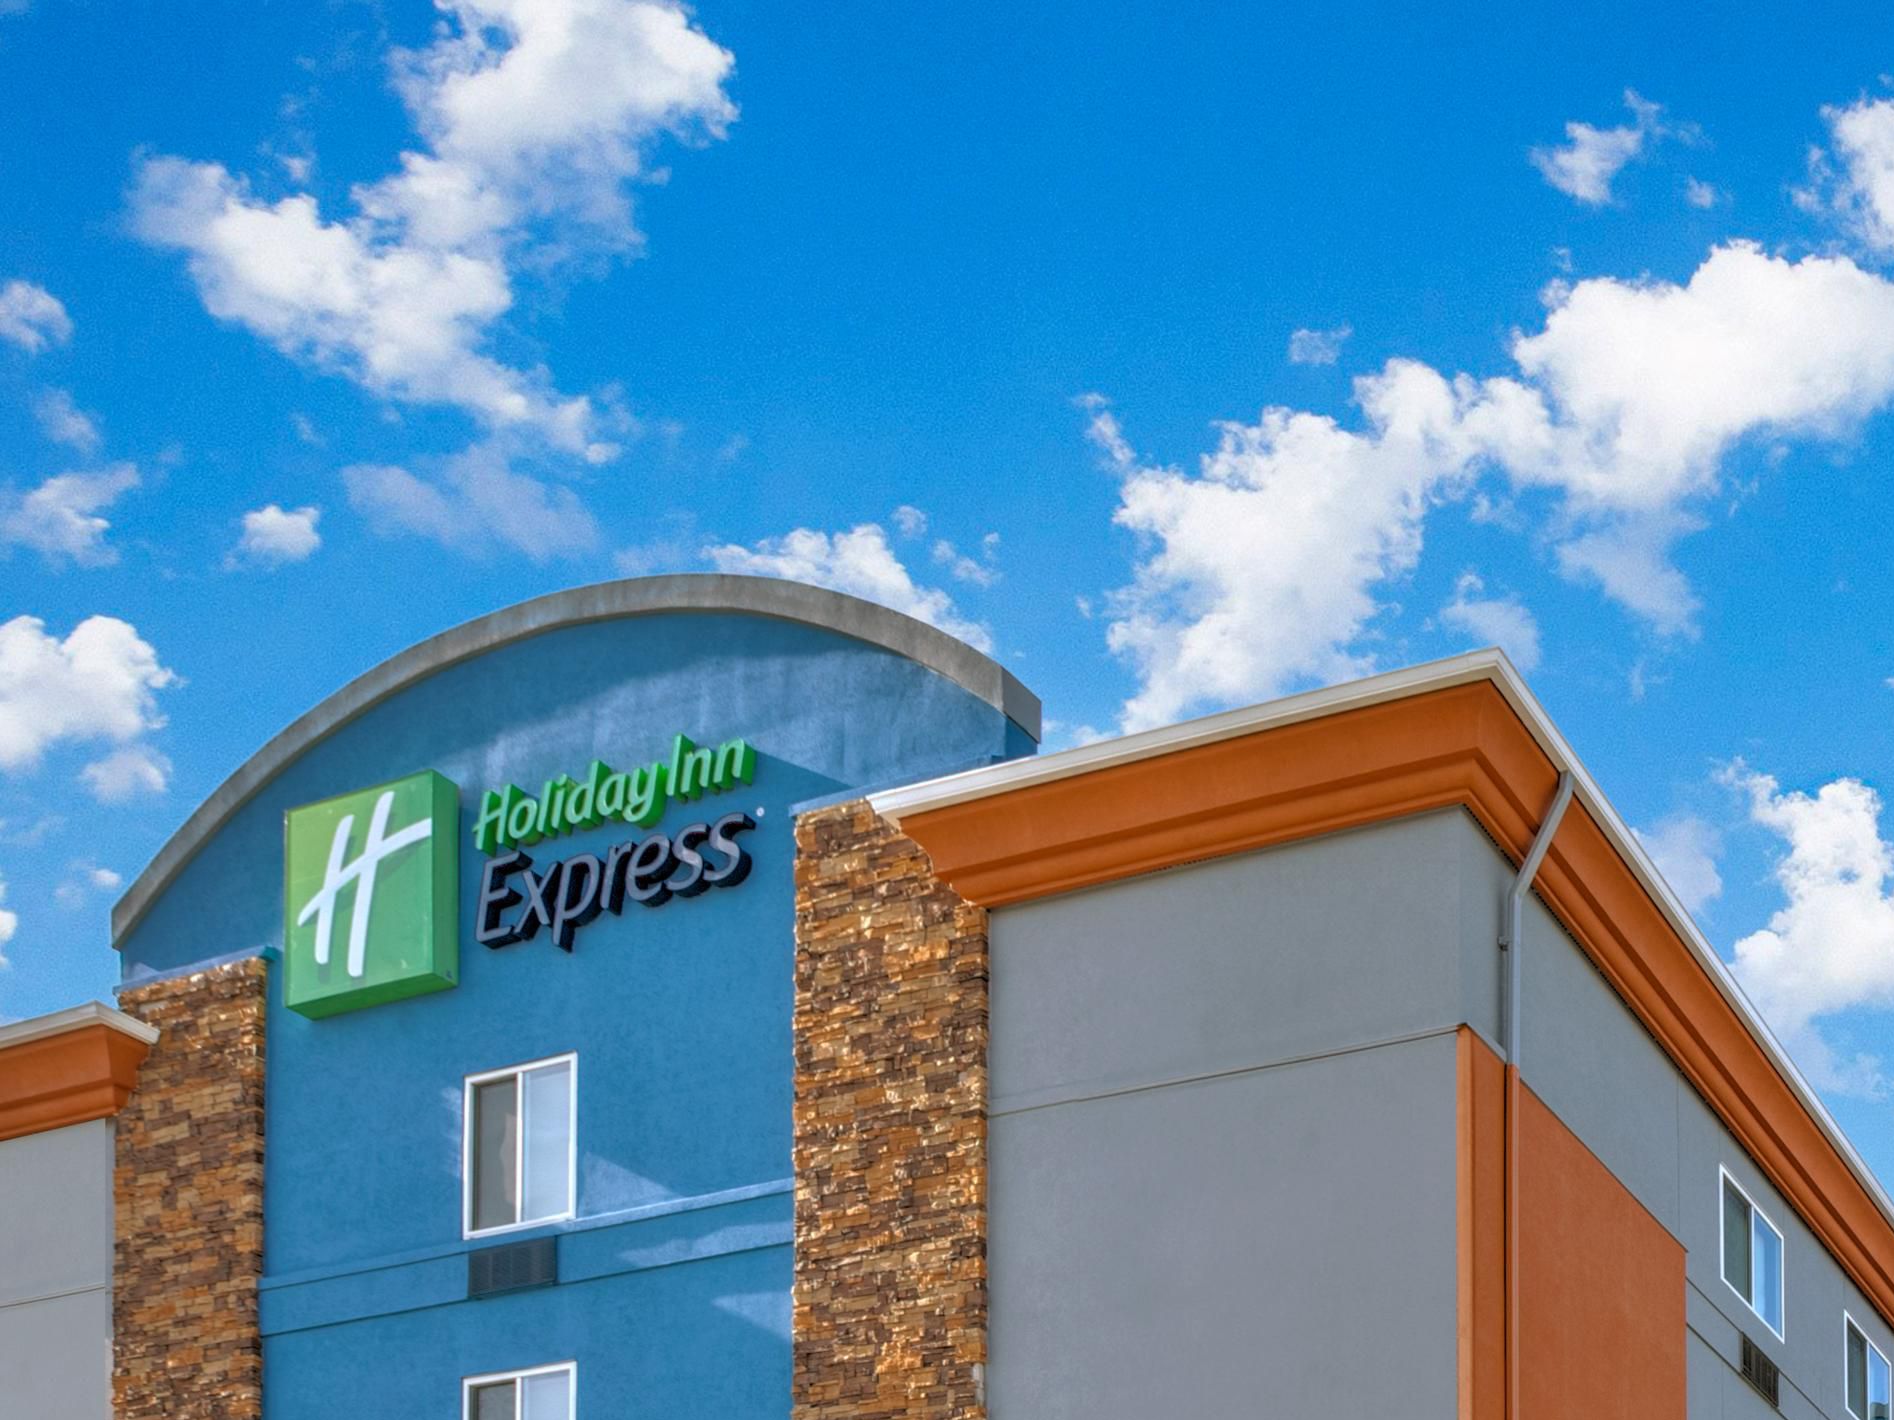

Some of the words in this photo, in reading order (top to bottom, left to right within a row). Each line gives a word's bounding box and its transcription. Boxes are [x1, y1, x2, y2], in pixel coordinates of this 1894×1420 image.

[473, 760, 667, 854] Holiday
[666, 733, 755, 803] Inn
[474, 812, 756, 952] Express
